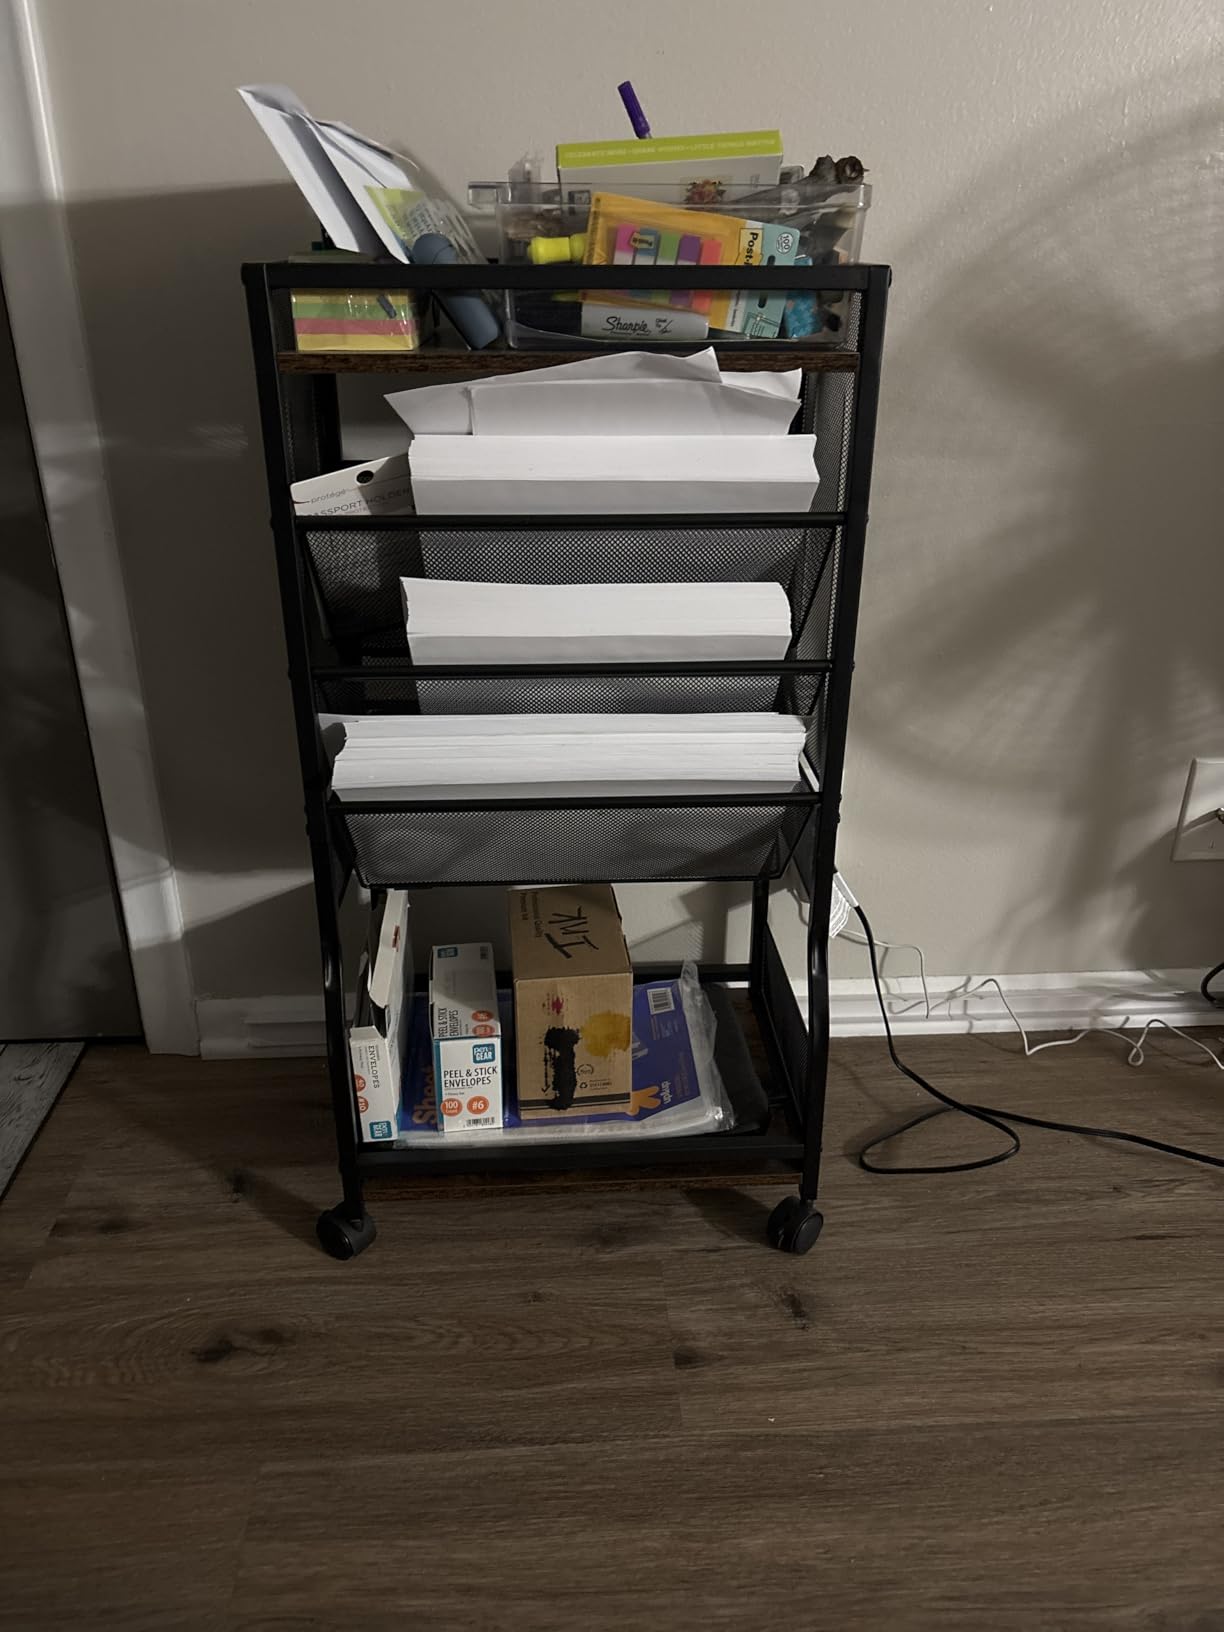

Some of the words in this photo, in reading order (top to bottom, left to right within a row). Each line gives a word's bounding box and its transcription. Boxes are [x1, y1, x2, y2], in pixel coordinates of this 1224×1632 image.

[781, 234, 792, 250] 100
[602, 316, 649, 333] Sharpie
[307, 500, 362, 516] ASSPORT
[448, 1010, 458, 1036] ENVELOPES
[368, 1045, 379, 1088] ENVELOPES
[443, 1069, 464, 1079] PEEL
[466, 1068, 472, 1077] &
[474, 1066, 498, 1076] STICK
[444, 1076, 492, 1088] ENVELOPES
[444, 1101, 458, 1109] 100
[472, 1101, 485, 1110] #6
